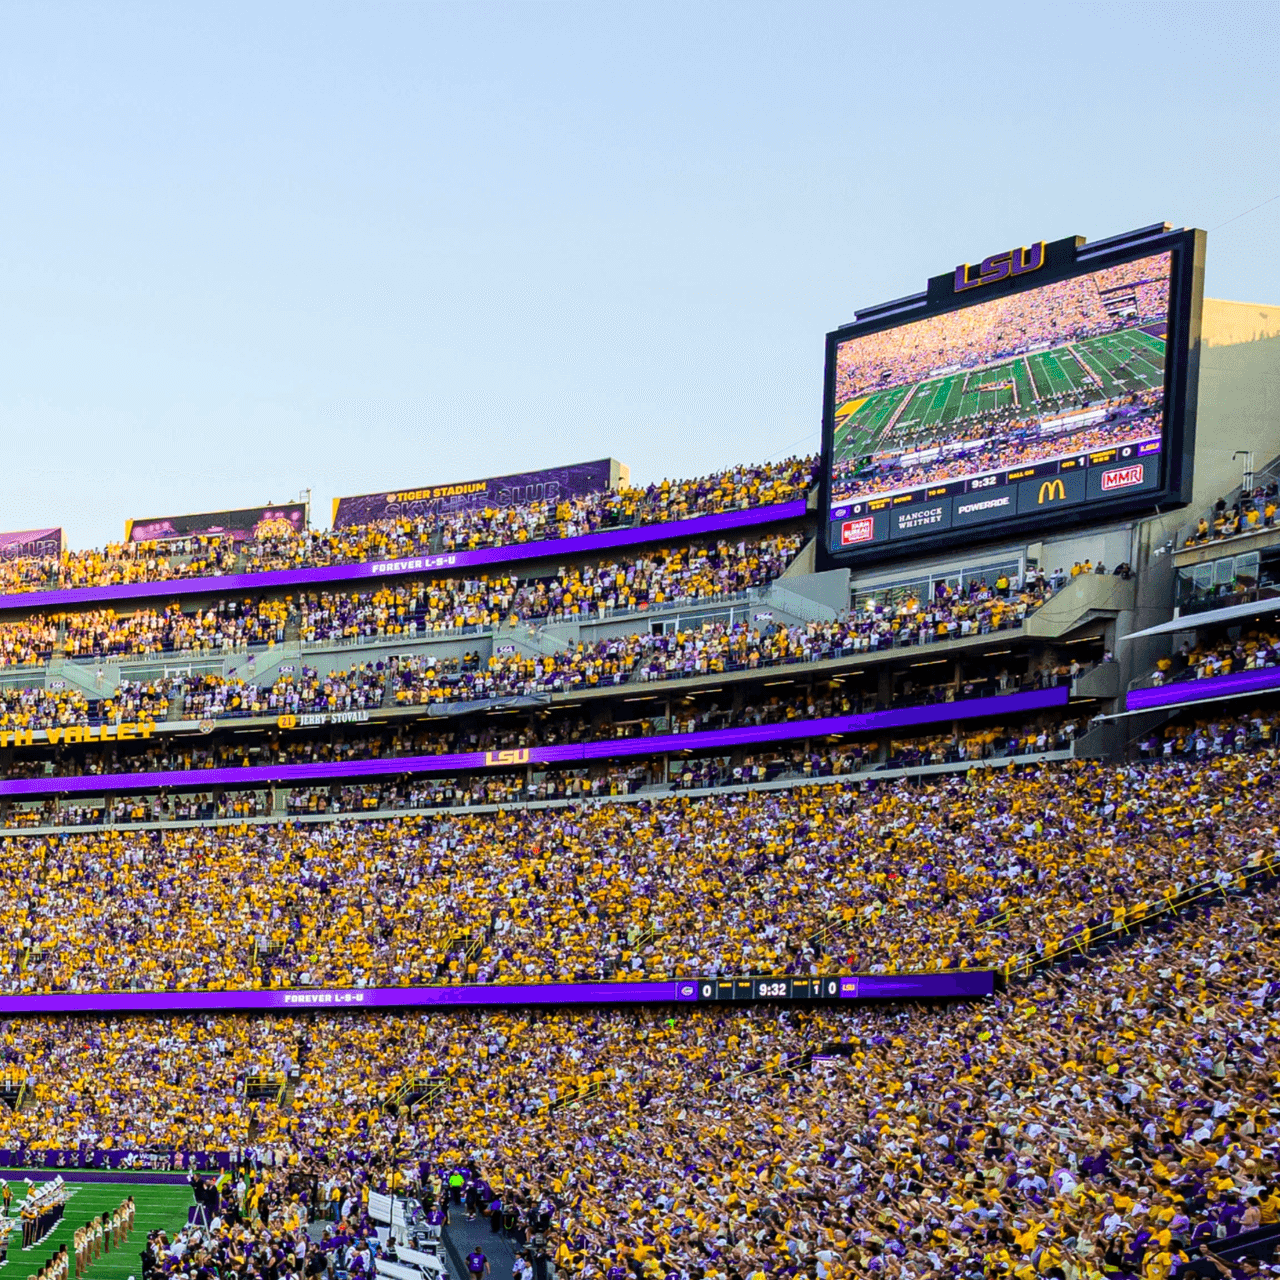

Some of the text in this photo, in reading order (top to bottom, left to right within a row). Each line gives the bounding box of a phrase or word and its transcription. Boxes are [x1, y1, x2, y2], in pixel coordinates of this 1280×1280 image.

[954, 240, 1046, 293] LSU
[1122, 447, 1131, 457] 0
[1078, 457, 1085, 466] 1
[971, 476, 996, 489] 9:32
[1106, 468, 1141, 486] MMR
[397, 482, 487, 502] TIGER STADIUM
[495, 480, 560, 508] CLUB
[854, 505, 861, 513] 0
[958, 497, 1010, 514] POWERADE
[899, 507, 942, 522] HANCOCK
[899, 515, 942, 529] WHITNEY
[2, 540, 58, 563] CLUB
[372, 556, 456, 573] FOREVER L-S-U
[281, 711, 369, 726] 21 JERRY STOVALL
[46, 722, 156, 745] VALLEY
[486, 748, 529, 766] LSU
[703, 985, 711, 997] 0
[759, 983, 786, 996] 9:32
[814, 985, 819, 995] 1
[828, 981, 836, 994] 0
[284, 993, 364, 1003] FOREVER L-S-U
